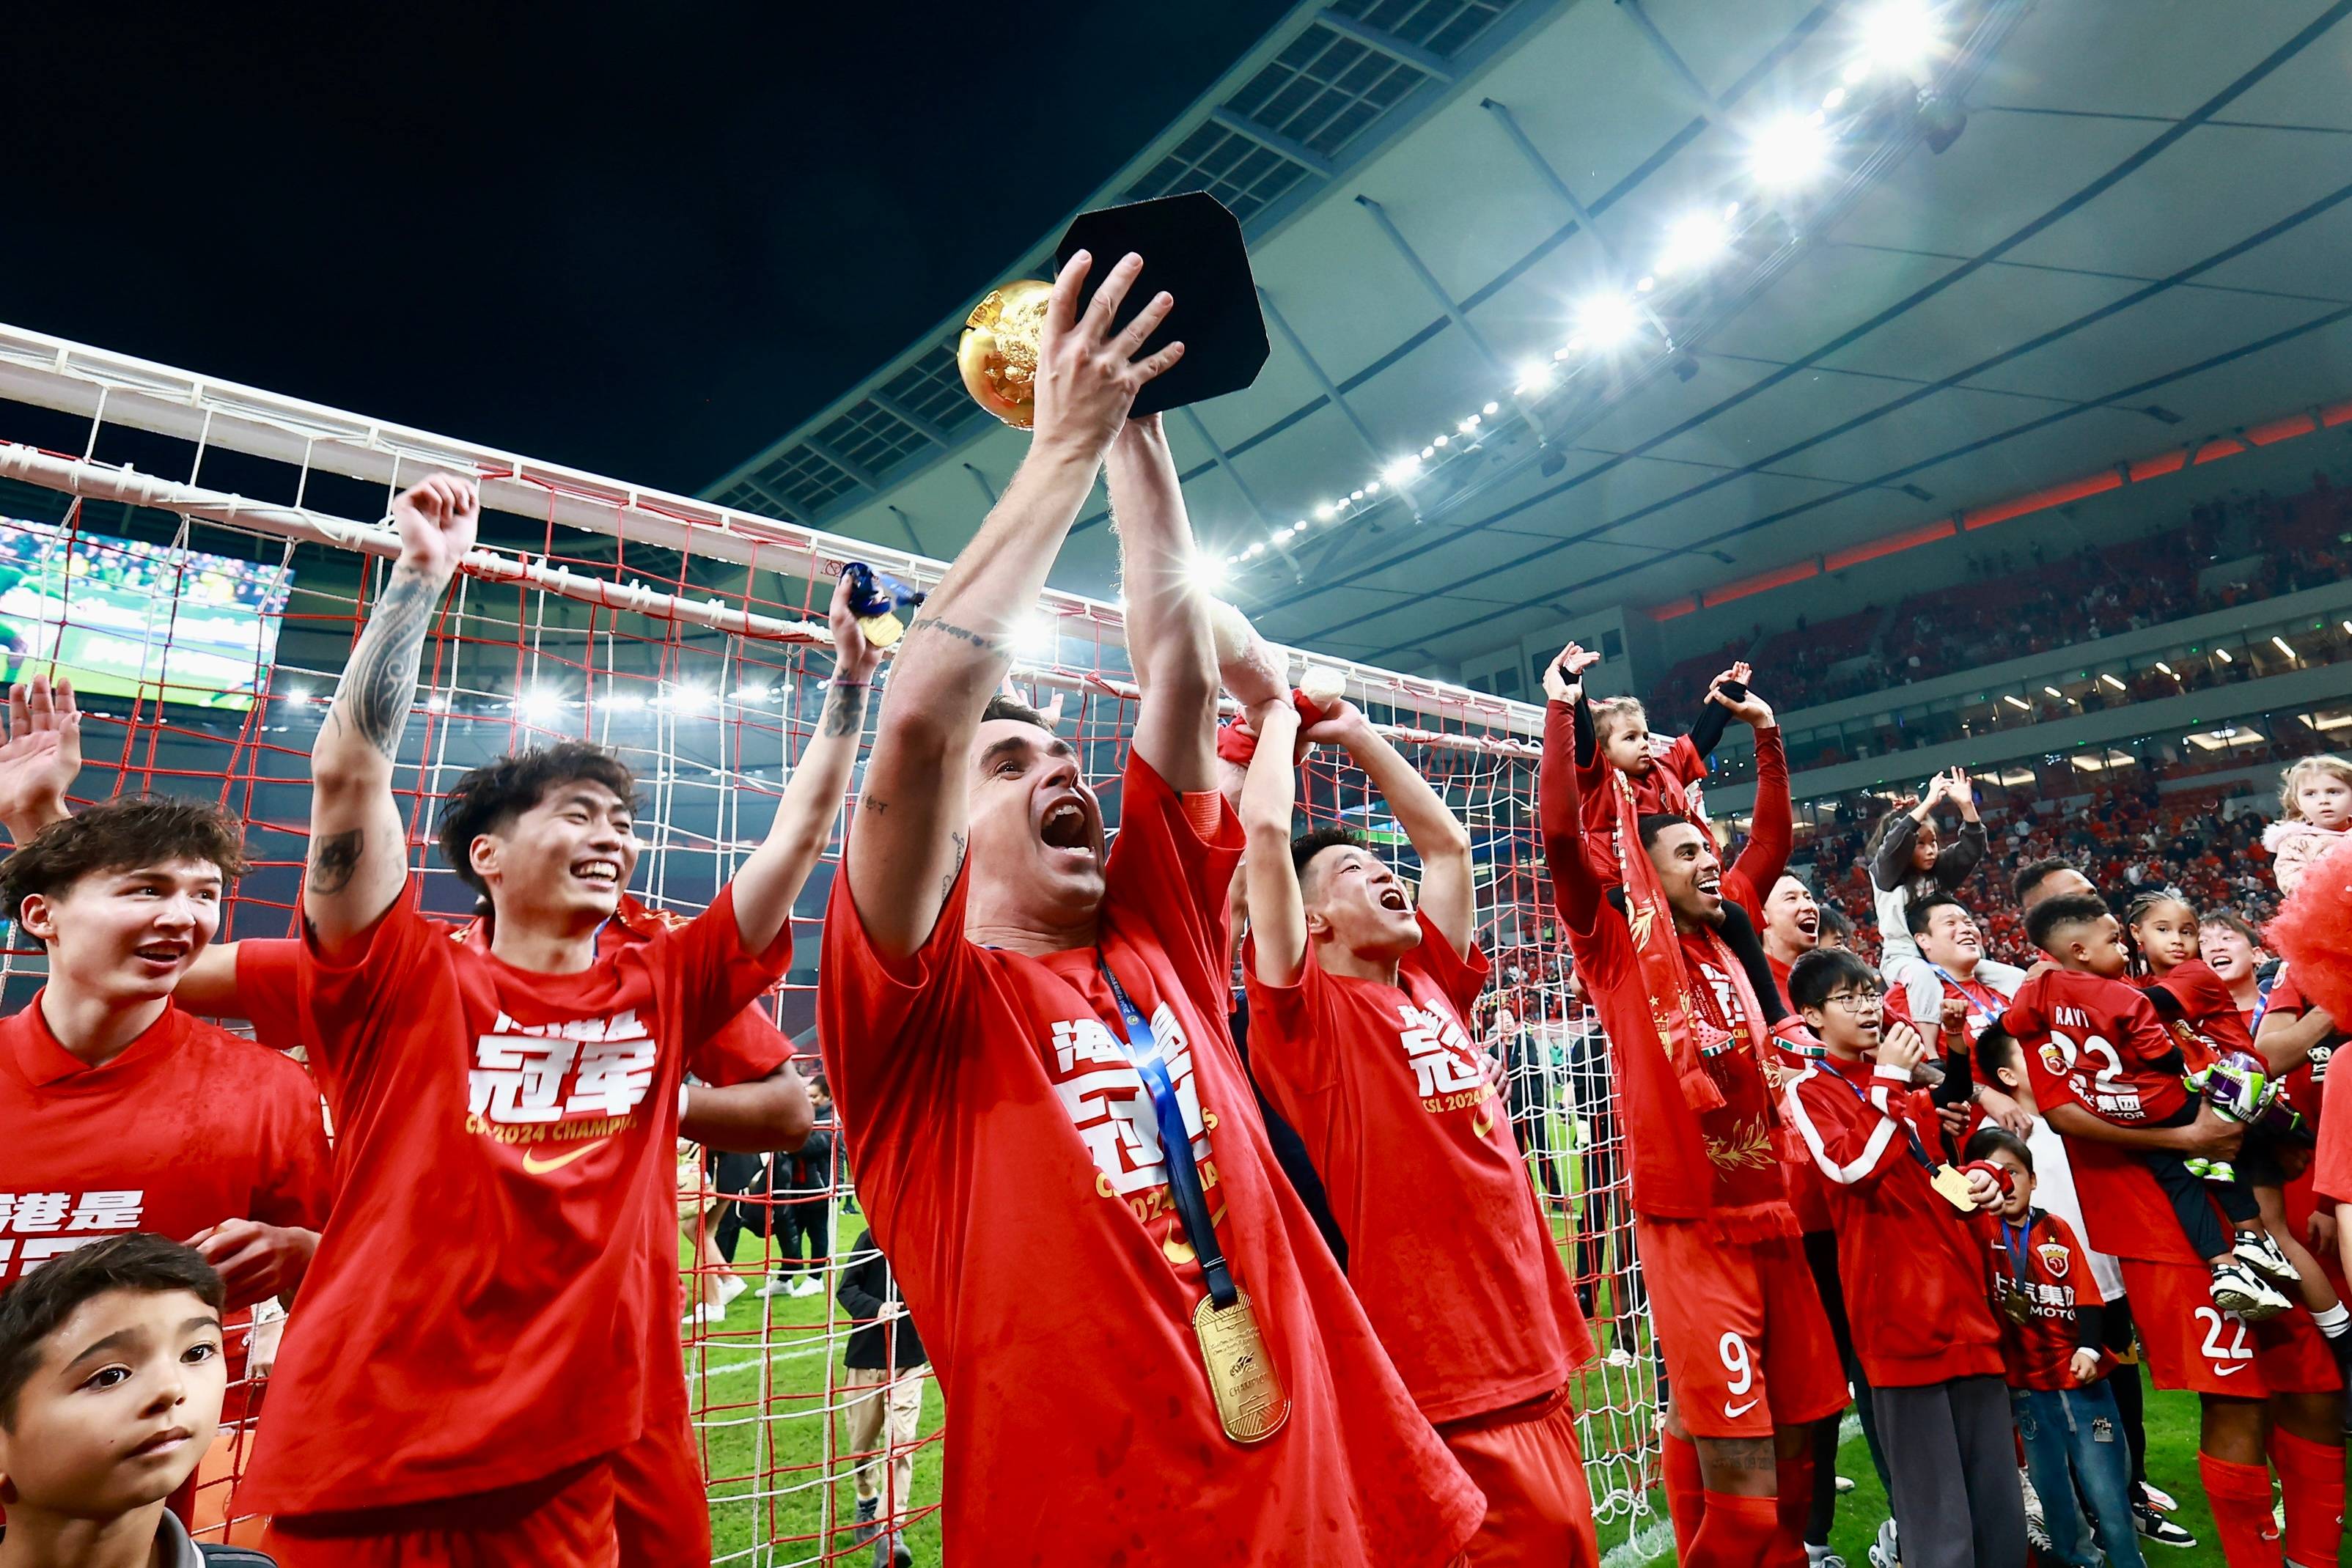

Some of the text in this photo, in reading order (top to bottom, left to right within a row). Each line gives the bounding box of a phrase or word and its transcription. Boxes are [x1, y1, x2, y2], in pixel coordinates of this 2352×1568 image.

[467, 1034, 656, 1123] 冠军
[1445, 1089, 1481, 1111] 2024
[493, 1124, 546, 1144] 2024
[0, 1190, 144, 1232] 港是
[1130, 1185, 1177, 1224] 024
[2029, 1305, 2076, 1321] MOTO
[2194, 1306, 2254, 1359] 22
[1719, 1331, 1752, 1396] 9
